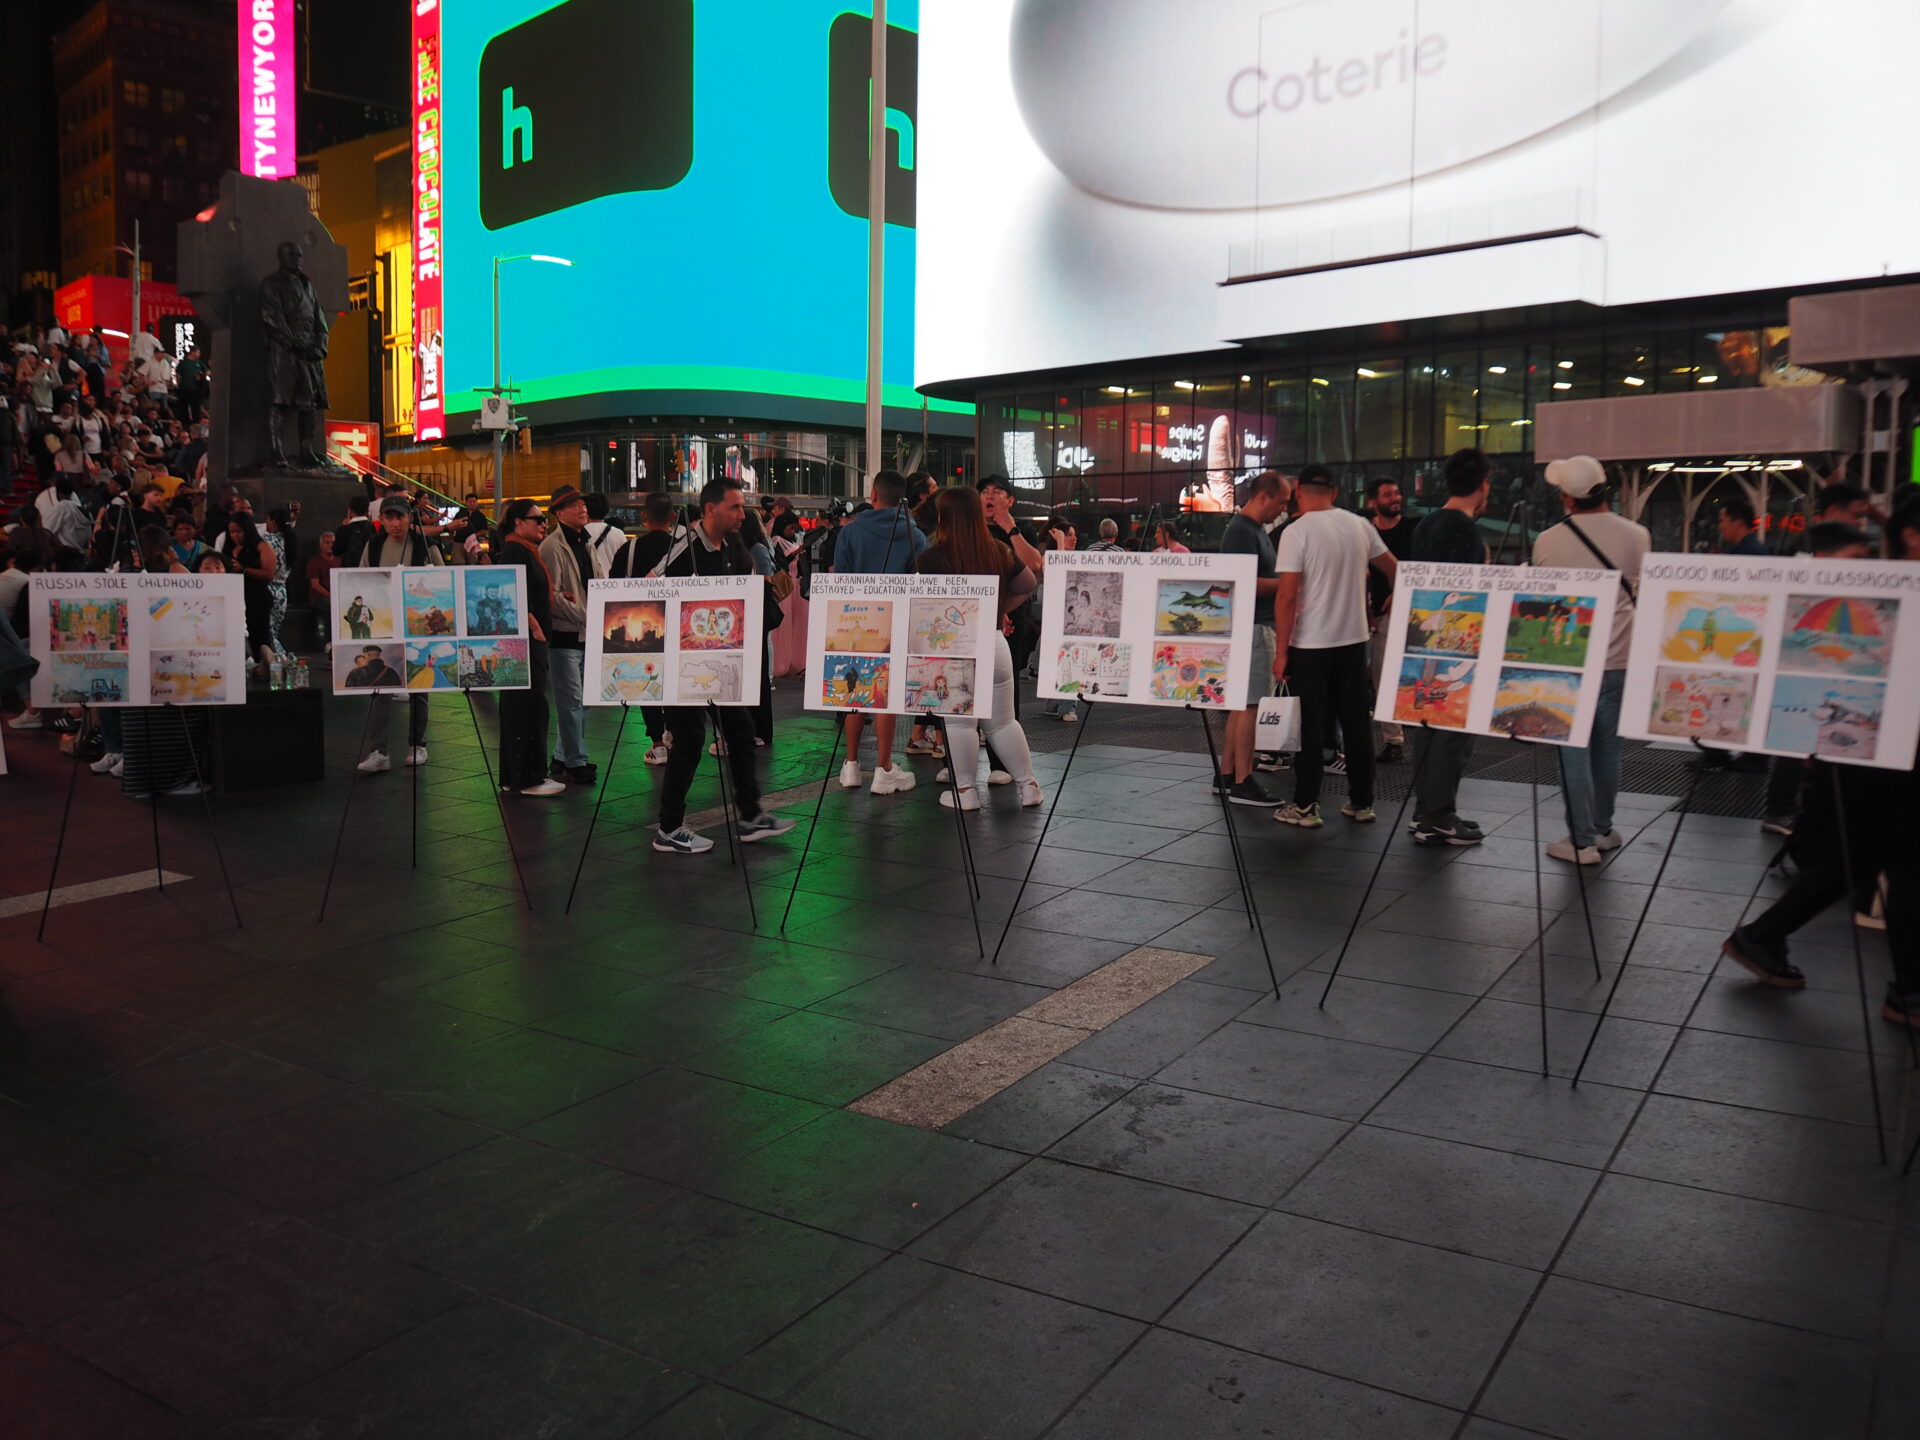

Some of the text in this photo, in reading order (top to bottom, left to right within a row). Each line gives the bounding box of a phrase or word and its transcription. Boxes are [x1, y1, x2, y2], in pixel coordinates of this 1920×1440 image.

[1226, 28, 1449, 119] Coterie
[418, 108, 440, 281] CHOCOLATE
[1048, 554, 1210, 567] BRING BACK NORMAL SCHOOL LIFE
[1400, 564, 1430, 575] WHEN
[1435, 566, 1474, 577] RUSSIA
[1524, 568, 1570, 580] LESSONS
[1575, 570, 1603, 582] STOP
[1711, 567, 1739, 582] KIDS
[1746, 568, 1783, 583] WITH
[1786, 569, 1810, 584] NO
[36, 577, 87, 590] RUSSIA
[94, 577, 128, 589] STOLE
[623, 579, 665, 588] UKRAINIAN
[671, 577, 710, 588] SCHOOLS
[715, 577, 731, 586] HIT
[736, 577, 748, 586] BY
[813, 575, 968, 586] 226 UKRAINIAN SCHOOLS HAVE BEEN
[1404, 577, 1558, 592] END ATTACKS ON EDUCATION
[648, 590, 680, 599] RUSSIA
[811, 585, 855, 594] DESTROYED
[863, 585, 907, 595] EDUCATION
[910, 586, 925, 595] HAS
[927, 586, 949, 595] BEEN
[950, 586, 996, 596] DESTROYED
[1259, 712, 1281, 725] Lids
